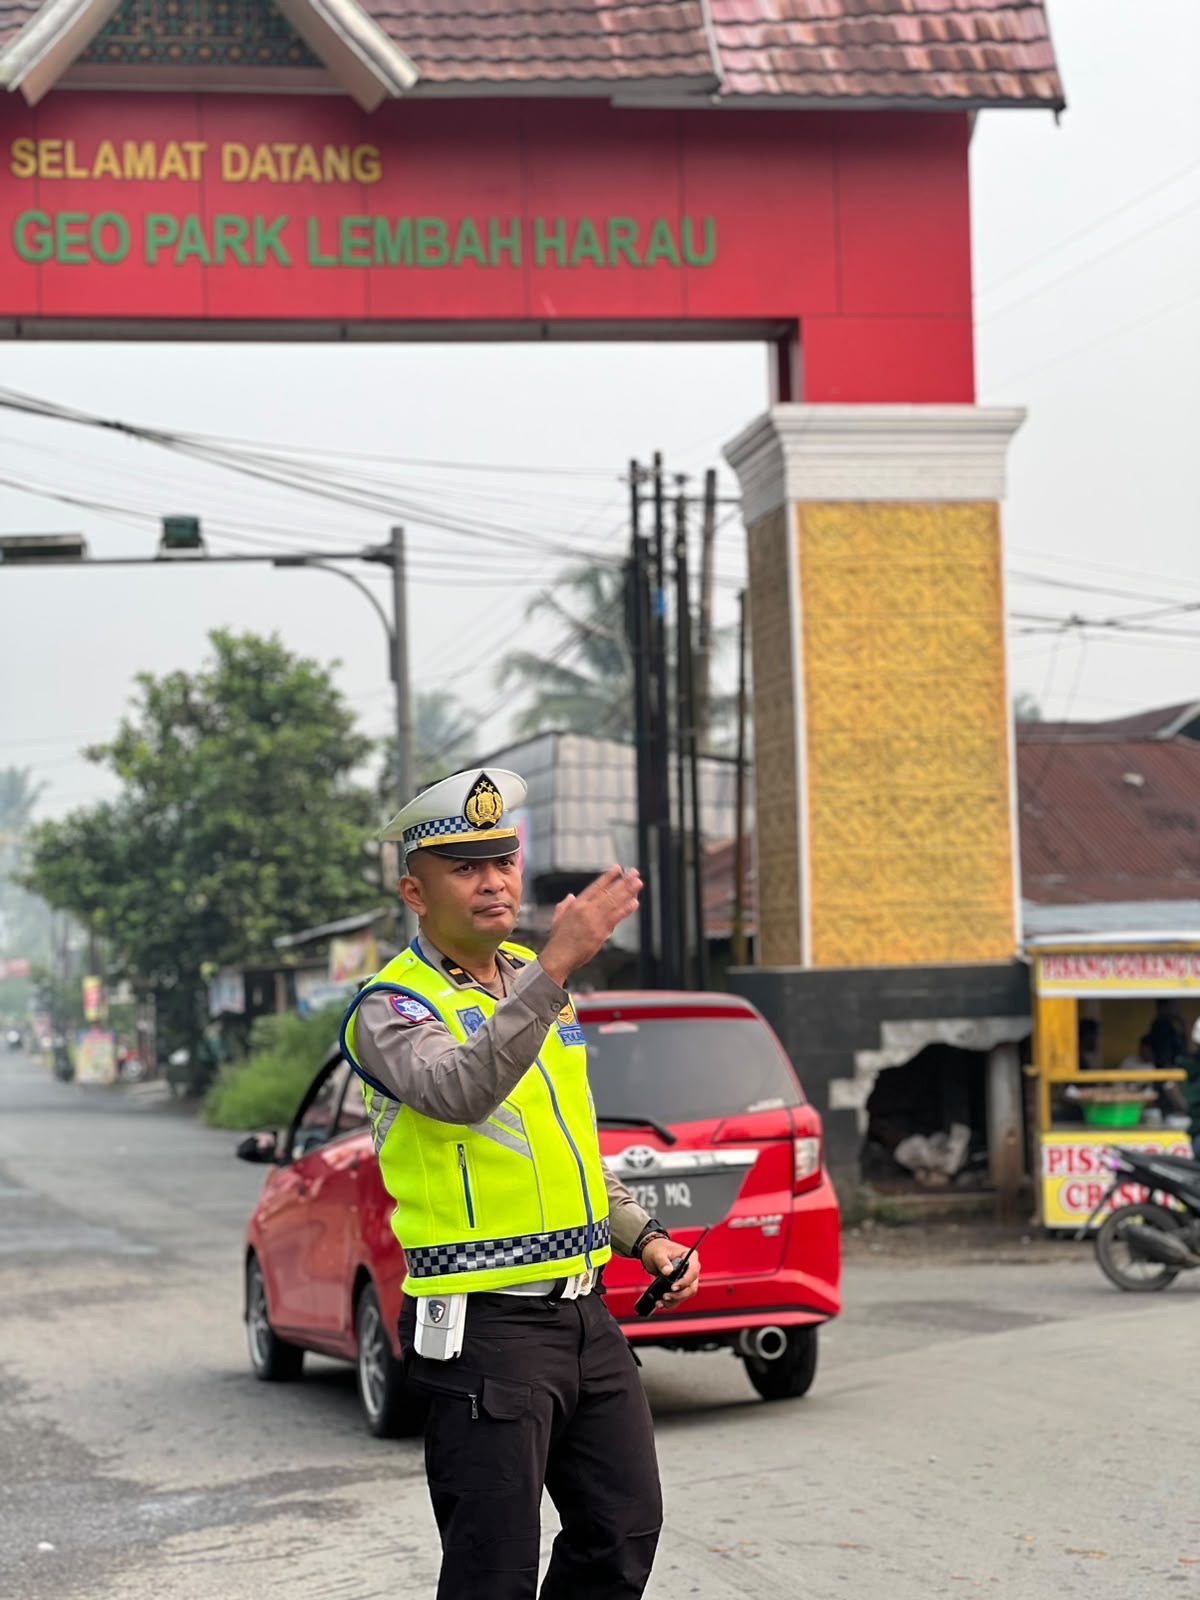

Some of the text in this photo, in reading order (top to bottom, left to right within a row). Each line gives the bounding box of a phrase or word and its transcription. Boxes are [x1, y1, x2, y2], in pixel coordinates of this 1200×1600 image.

[10, 138, 382, 183] SELAMAT DATANG
[14, 210, 717, 267] GEO PARK LEMBAH HARAU
[664, 1182, 692, 1208] MQ
